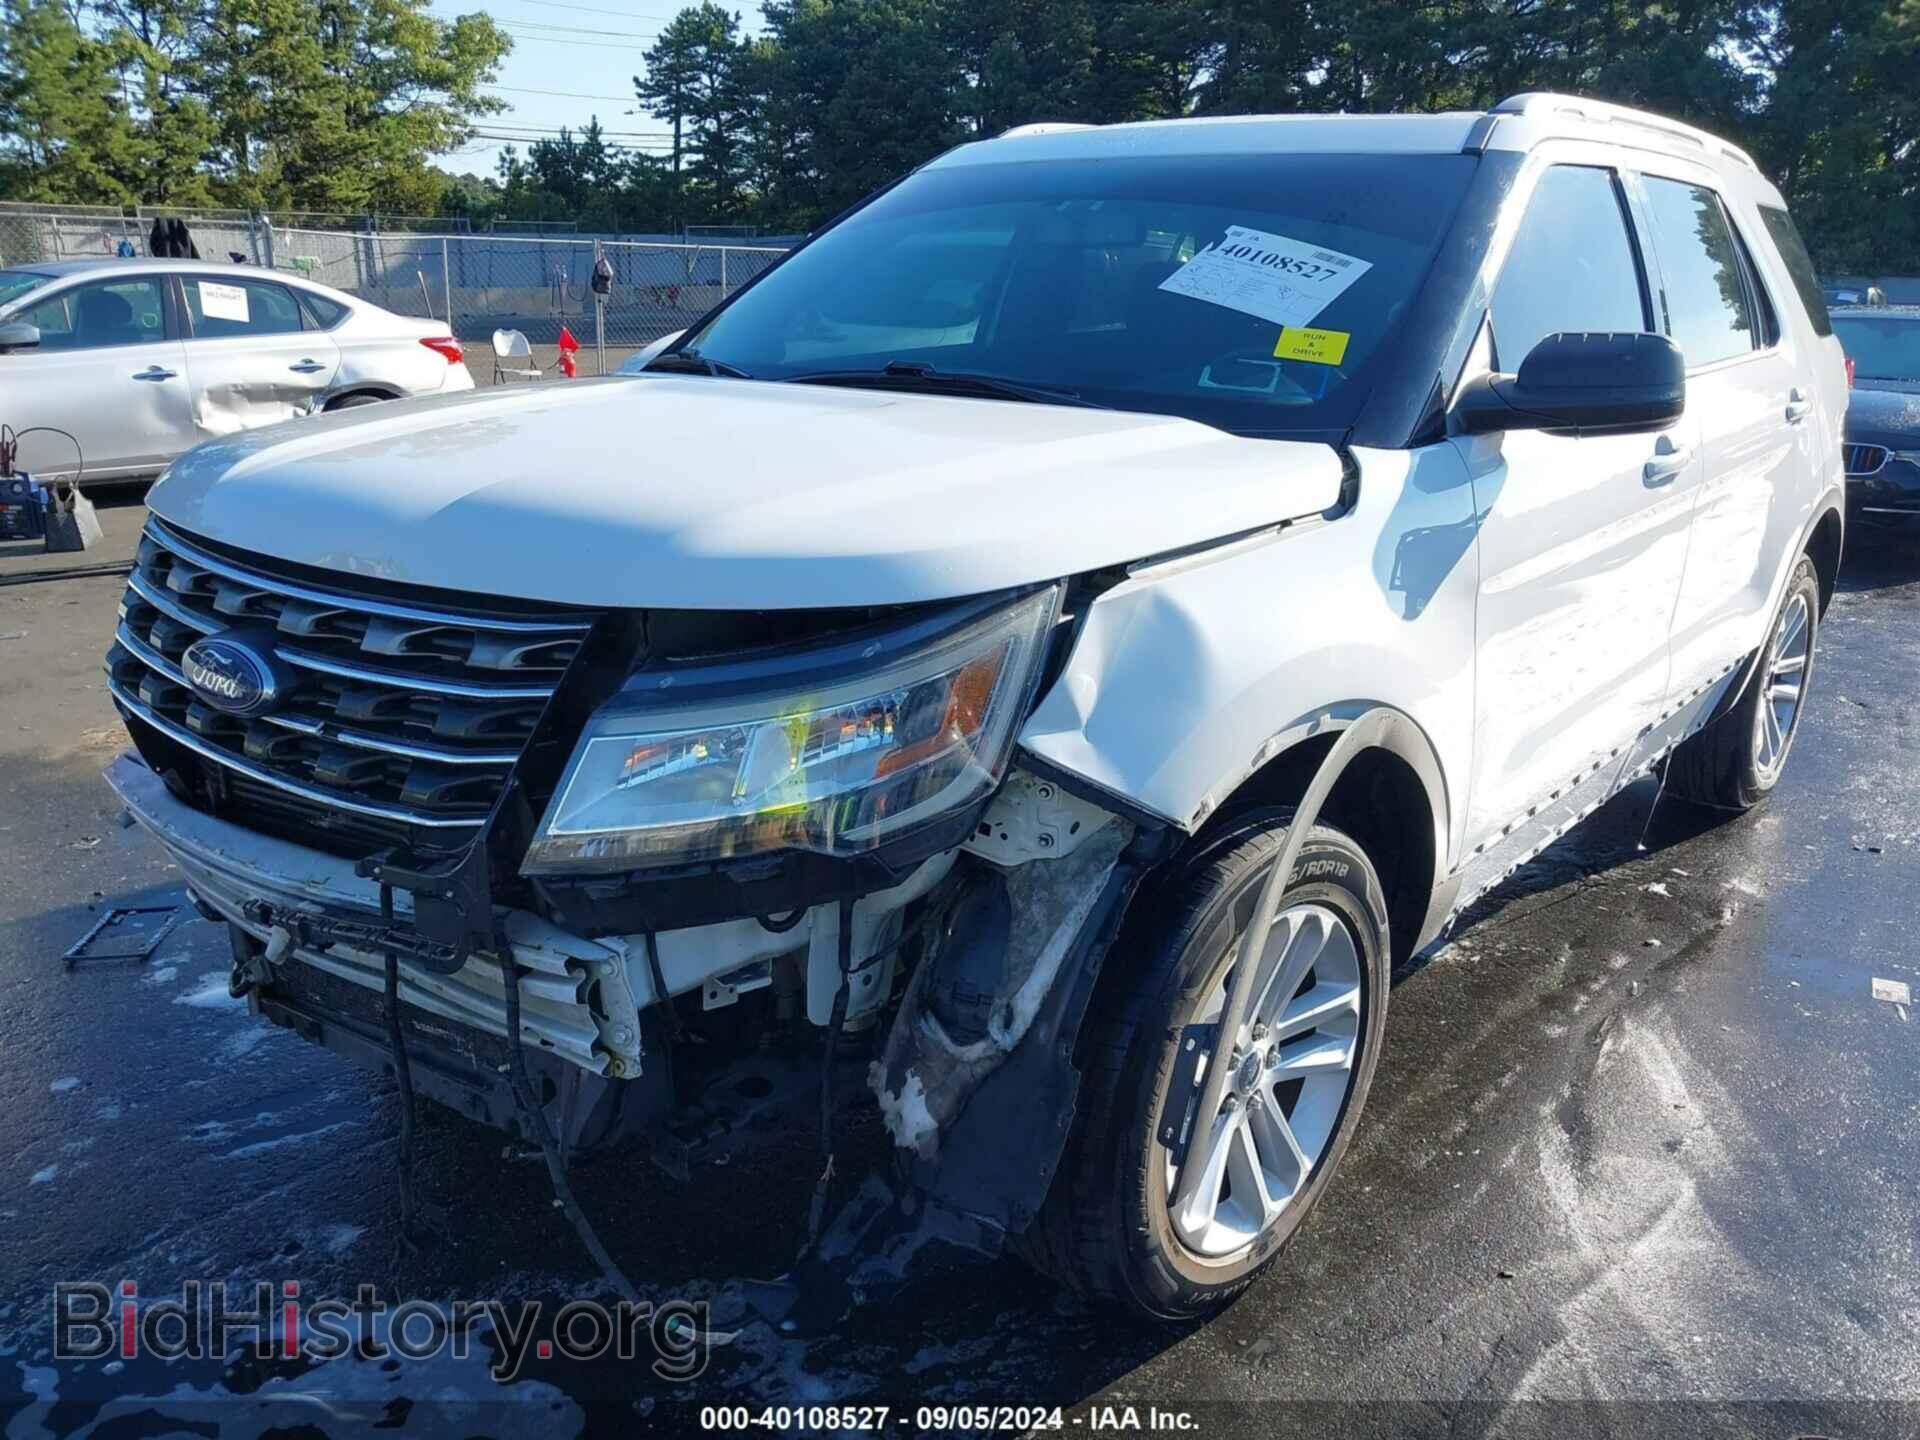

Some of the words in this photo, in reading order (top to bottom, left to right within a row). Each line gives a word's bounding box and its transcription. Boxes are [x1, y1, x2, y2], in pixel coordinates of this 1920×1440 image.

[1221, 243, 1339, 282] 40108527
[1303, 332, 1327, 341] RUN
[1292, 347, 1324, 357] DRIVE
[192, 649, 247, 699] Ford
